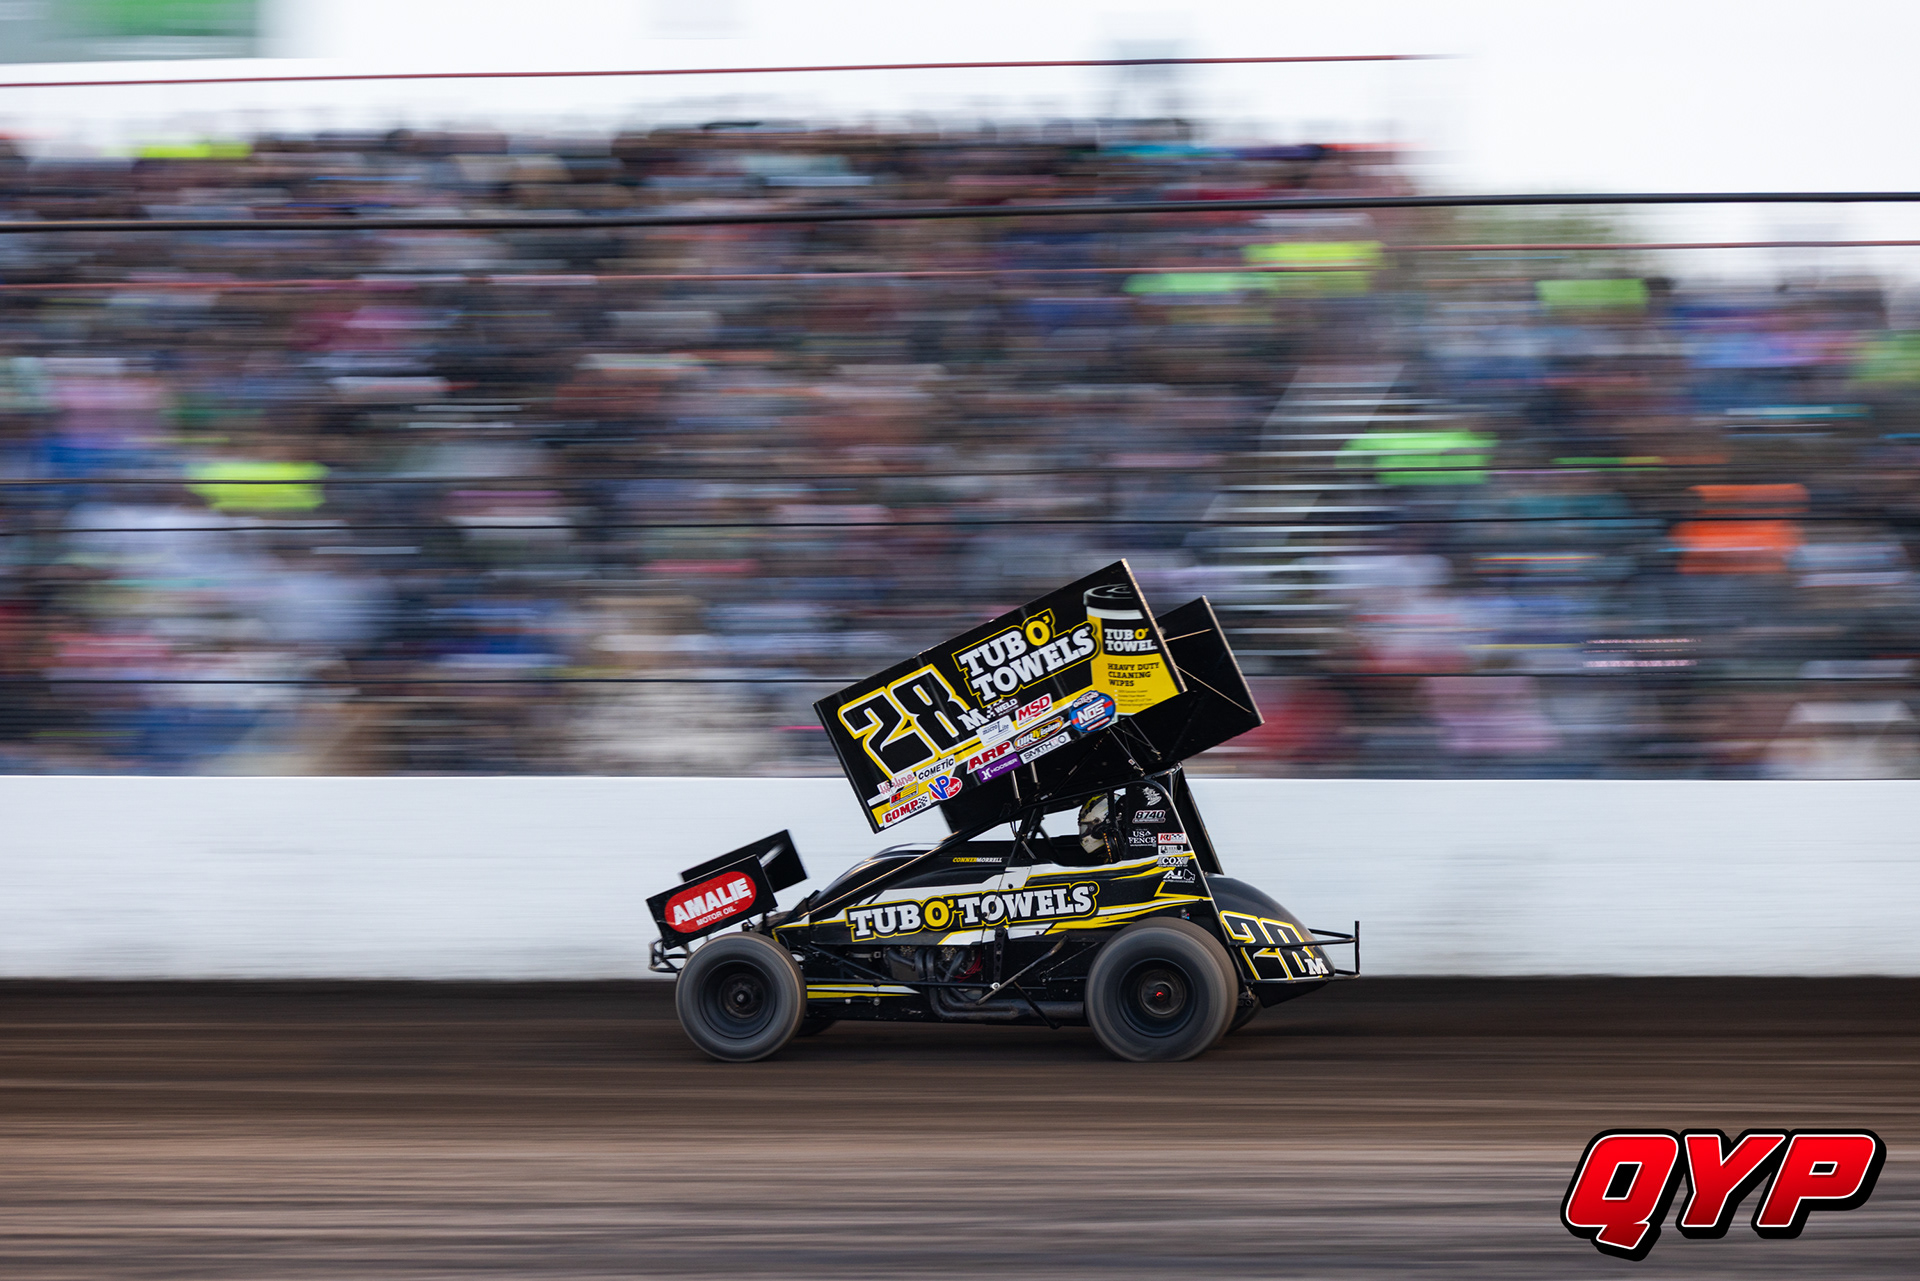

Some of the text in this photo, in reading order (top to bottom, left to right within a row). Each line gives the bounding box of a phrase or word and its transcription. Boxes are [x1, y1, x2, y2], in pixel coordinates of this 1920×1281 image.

[1104, 628, 1134, 640] TUB
[958, 630, 1027, 677] TUB
[970, 628, 1095, 702] TOWELS
[1107, 662, 1160, 671] HEAVY DUTY
[1108, 671, 1151, 679] CLEANING
[1108, 679, 1135, 687] WIPES
[1018, 696, 1050, 721] MSD
[1076, 698, 1106, 724] NOS
[968, 741, 1011, 771] ARP
[928, 775, 950, 800] VP
[885, 800, 919, 823] COMP
[1135, 810, 1164, 819] 8740
[1128, 836, 1156, 844] FENCE
[1161, 857, 1184, 865] COX
[672, 877, 751, 926] AMALIE
[850, 904, 921, 937] TUB
[958, 886, 1092, 924] TOWELS
[696, 905, 737, 926] MOTOR OIL
